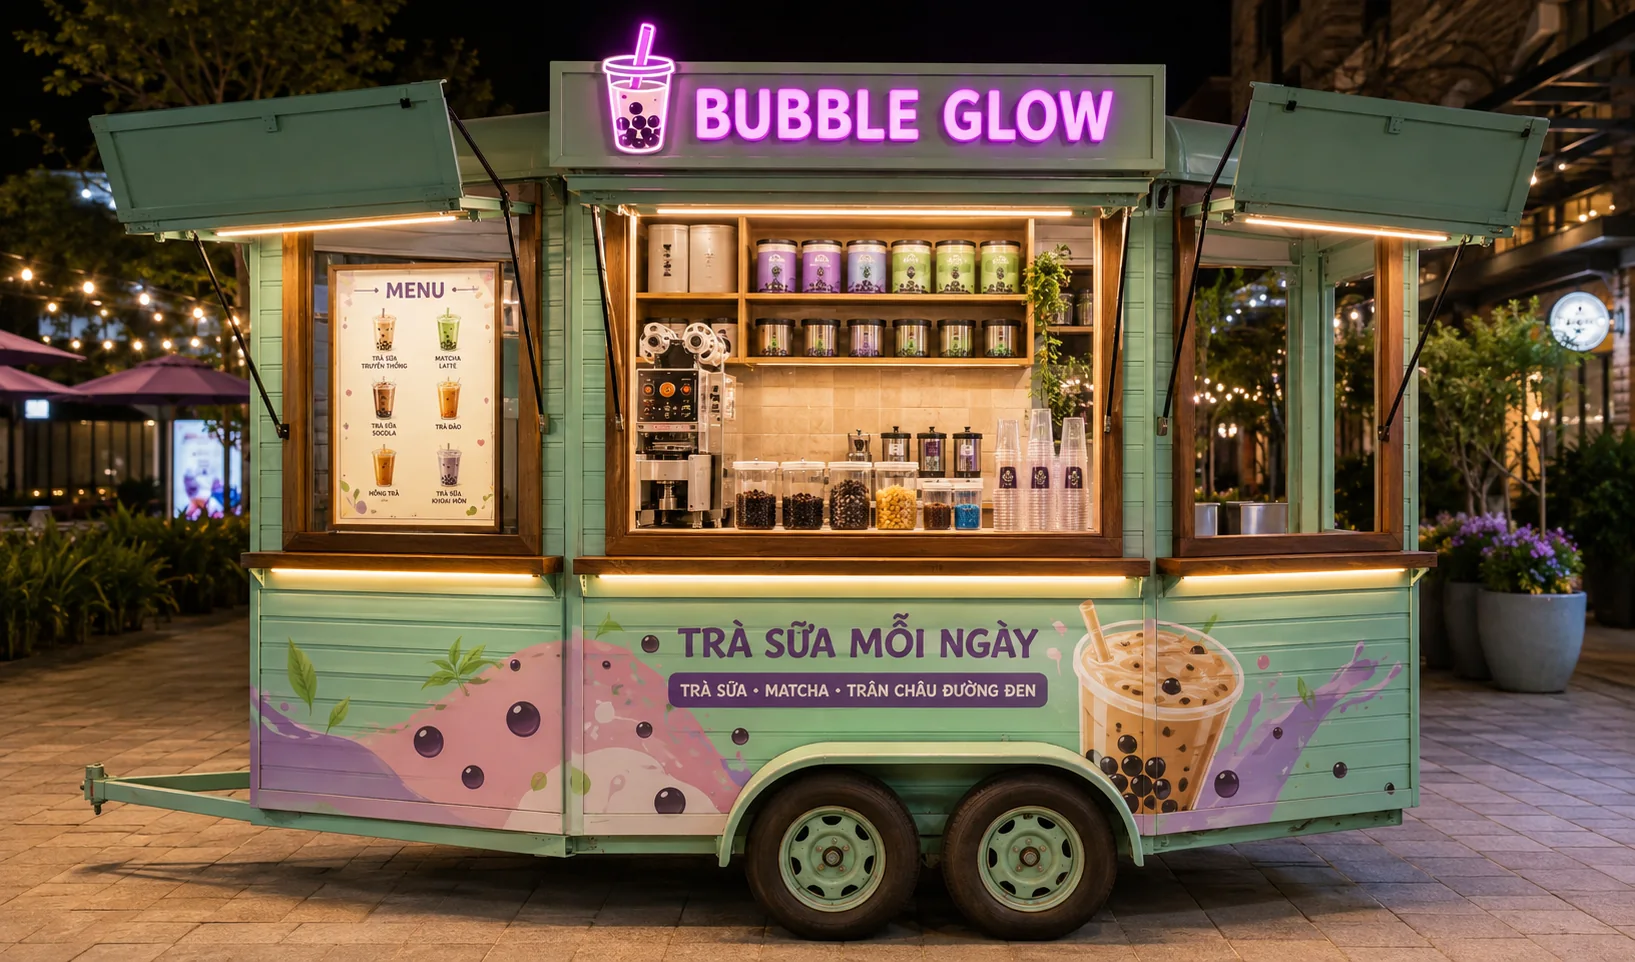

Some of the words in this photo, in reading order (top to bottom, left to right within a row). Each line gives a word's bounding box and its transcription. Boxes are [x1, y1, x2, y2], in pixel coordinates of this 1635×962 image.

[695, 88, 919, 142] BUBBLE
[943, 88, 1114, 142] GLOW
[386, 281, 445, 299] MENU
[677, 619, 753, 659] TRÀ
[765, 620, 836, 659] SỮA
[850, 612, 925, 659] MỖI
[940, 619, 1039, 659] NGÀY
[680, 680, 711, 698] TRÀ
[717, 680, 748, 698] SỮA
[765, 683, 829, 698] MATCHA
[847, 681, 889, 698] TRÂN
[894, 681, 937, 698] CHÂU
[942, 679, 999, 698] ĐƯỜNG
[1004, 683, 1037, 698] ĐEN
